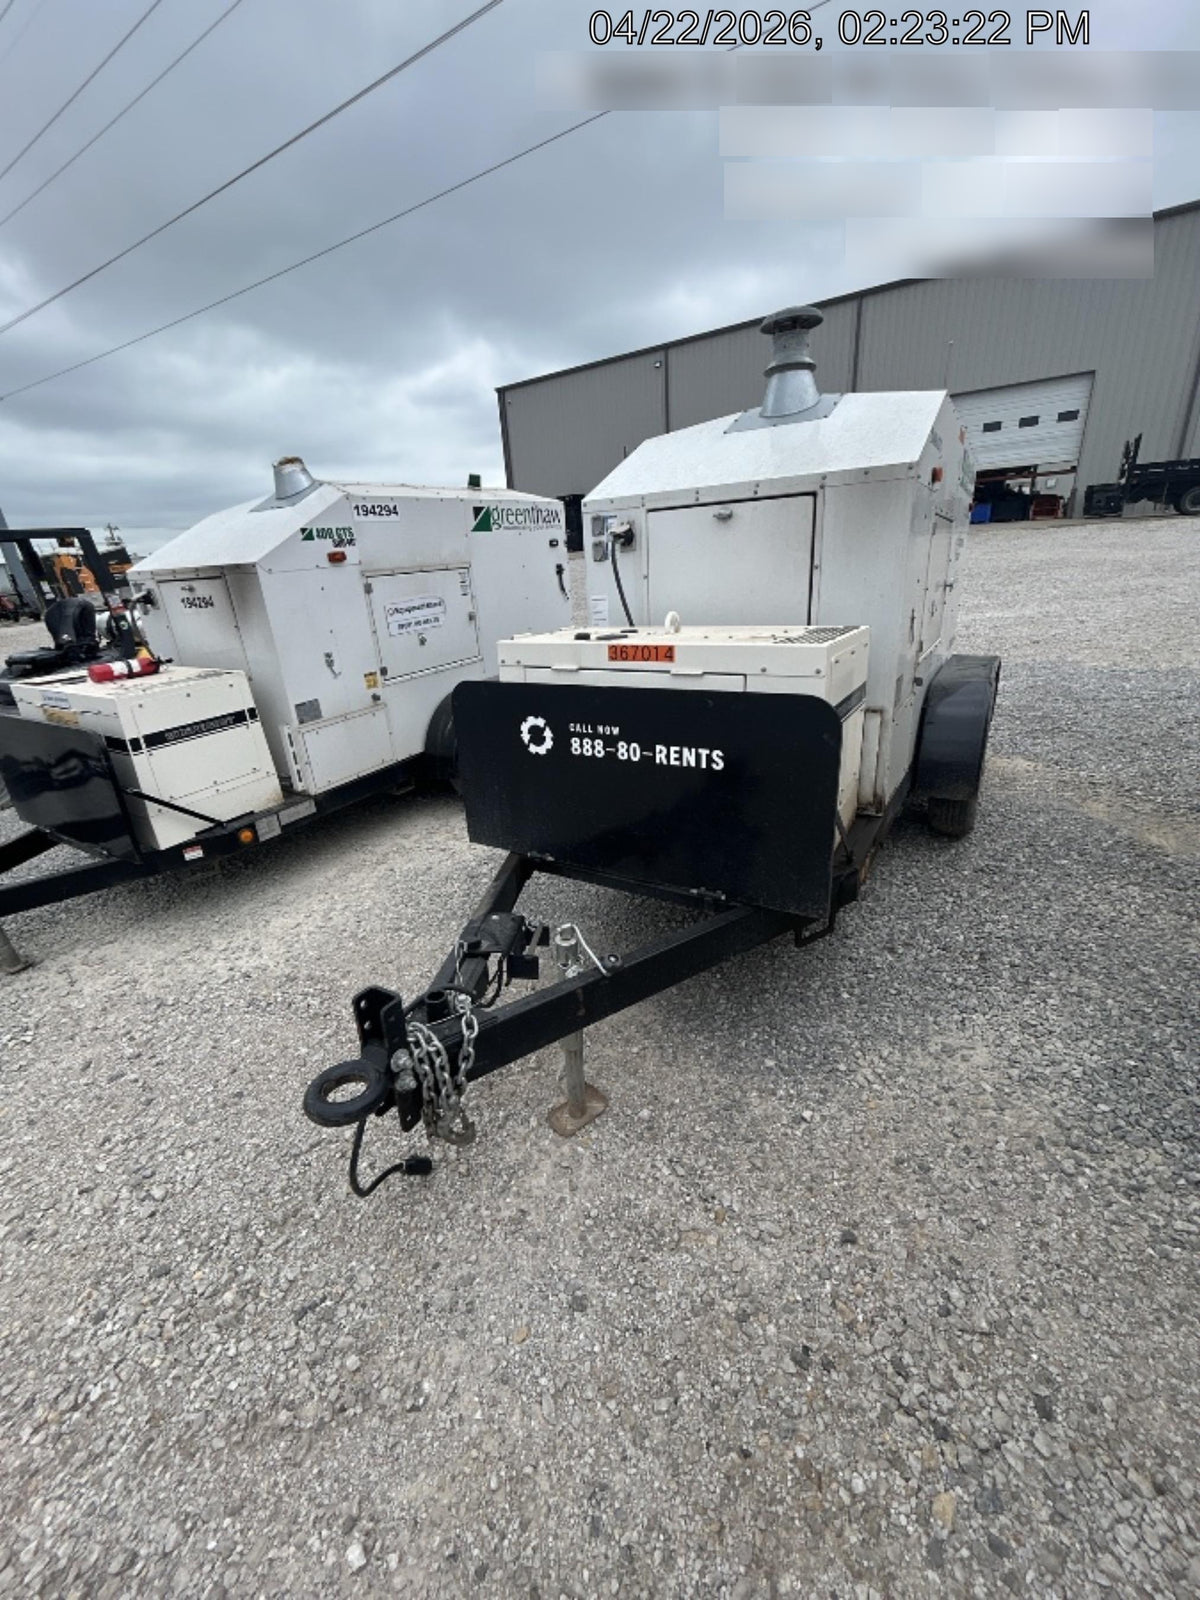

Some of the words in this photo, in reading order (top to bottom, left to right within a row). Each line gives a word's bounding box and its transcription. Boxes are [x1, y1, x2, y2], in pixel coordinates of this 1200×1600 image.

[353, 504, 399, 516] 194294
[491, 504, 561, 530] greenthaw
[609, 645, 674, 661] 367014
[569, 723, 593, 734] CALL
[597, 725, 620, 736] NOW
[570, 737, 725, 771] 888-80-RENTS
